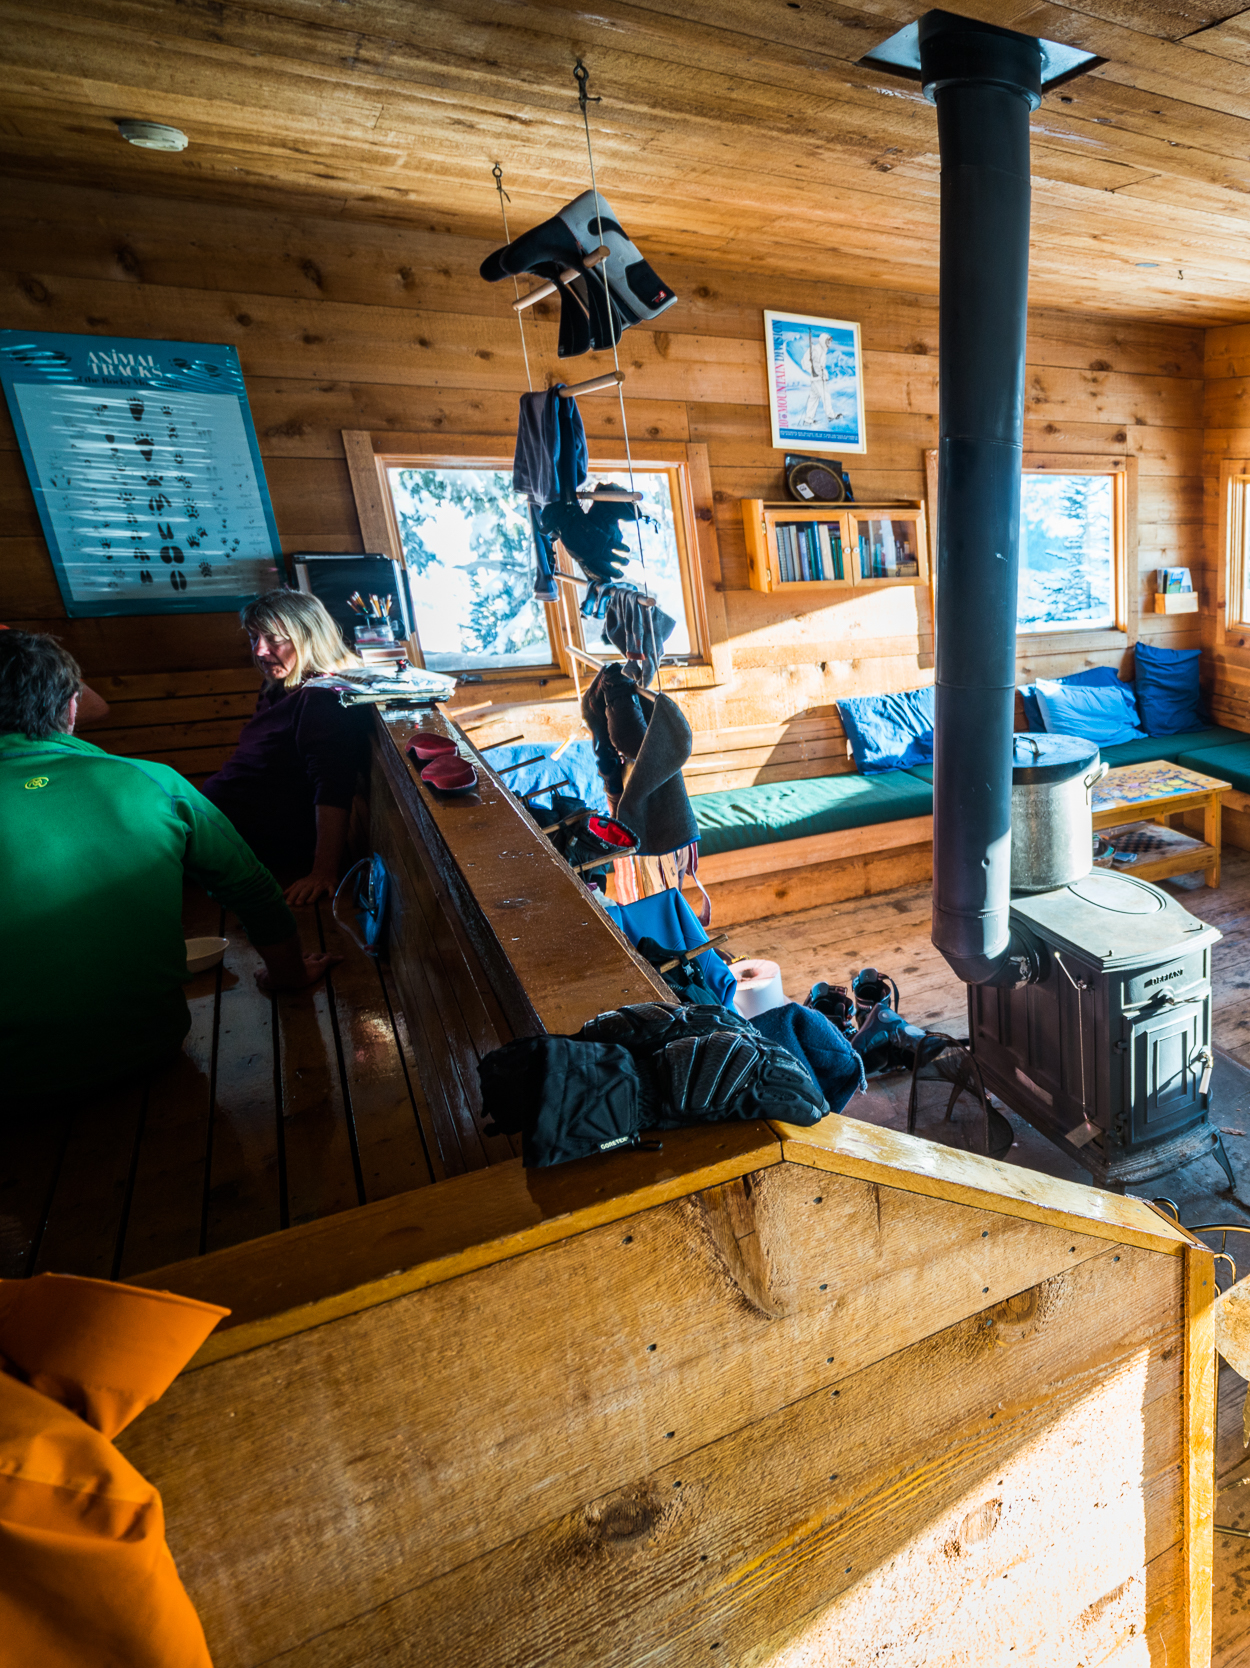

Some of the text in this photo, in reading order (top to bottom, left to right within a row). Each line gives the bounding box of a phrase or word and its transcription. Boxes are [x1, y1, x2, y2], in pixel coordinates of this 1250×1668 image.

[772, 320, 785, 363] DIVISION
[90, 363, 163, 379] TRACKS
[102, 378, 131, 387] Rocky
[775, 363, 788, 413] MOUNTAIN
